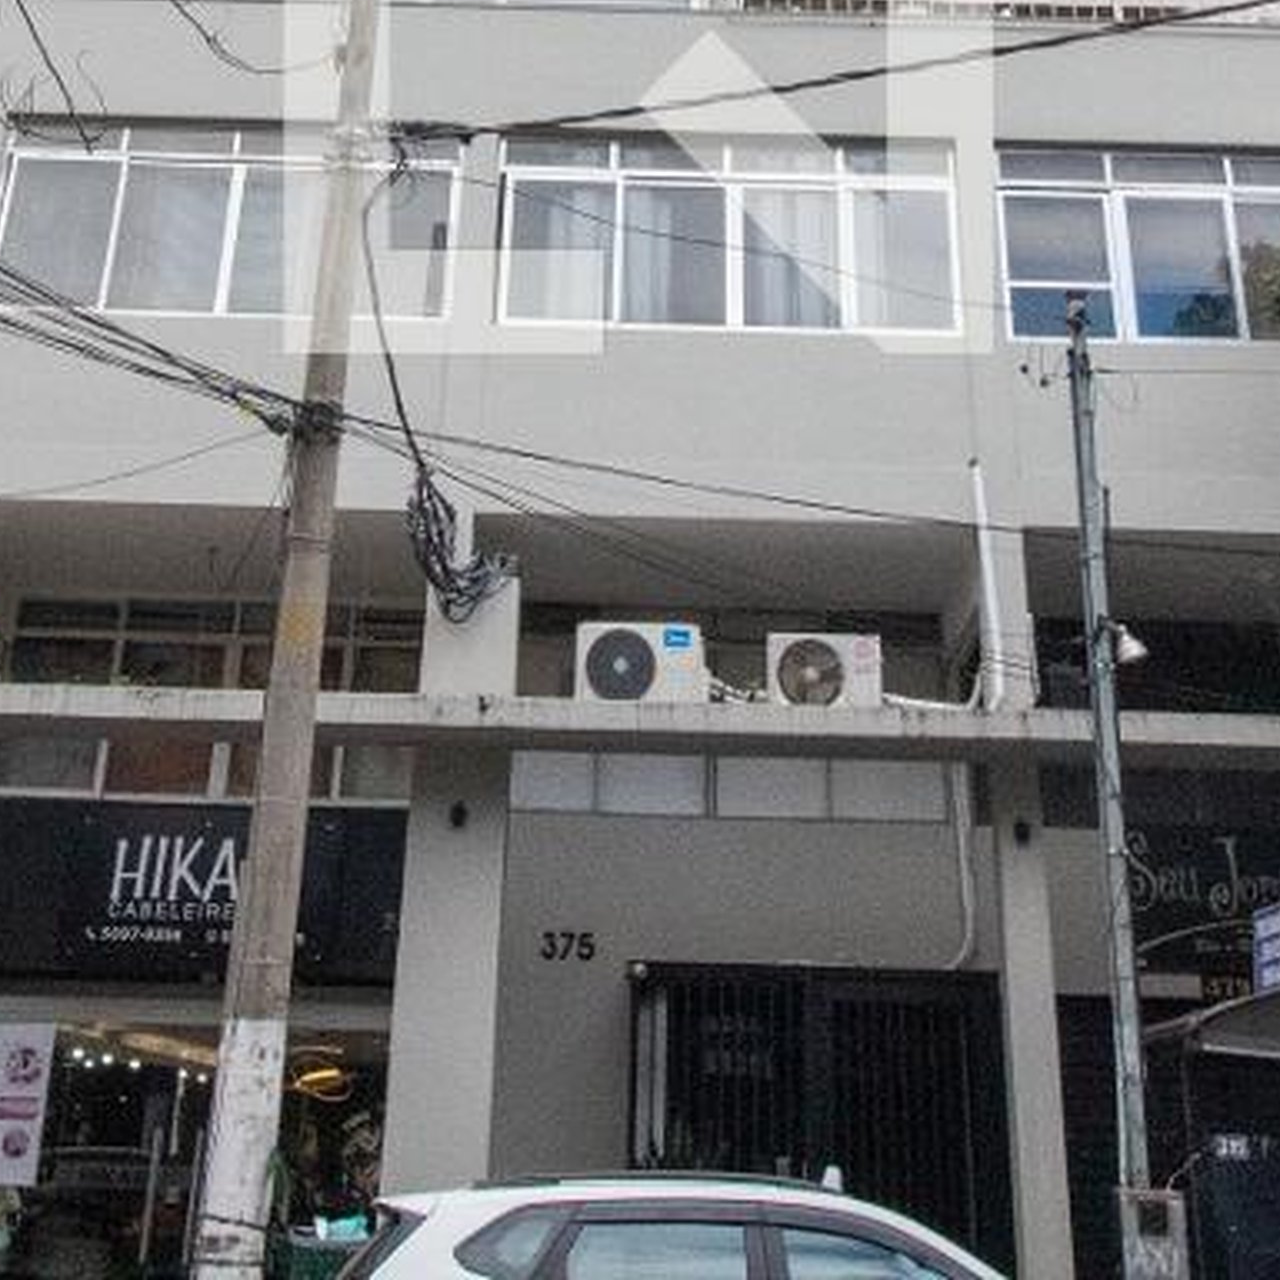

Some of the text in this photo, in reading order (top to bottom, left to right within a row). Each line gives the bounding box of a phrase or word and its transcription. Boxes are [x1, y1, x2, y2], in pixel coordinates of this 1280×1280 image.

[110, 834, 240, 902] HIKA
[108, 900, 236, 923] CABELEIRE
[541, 932, 595, 960] 375
